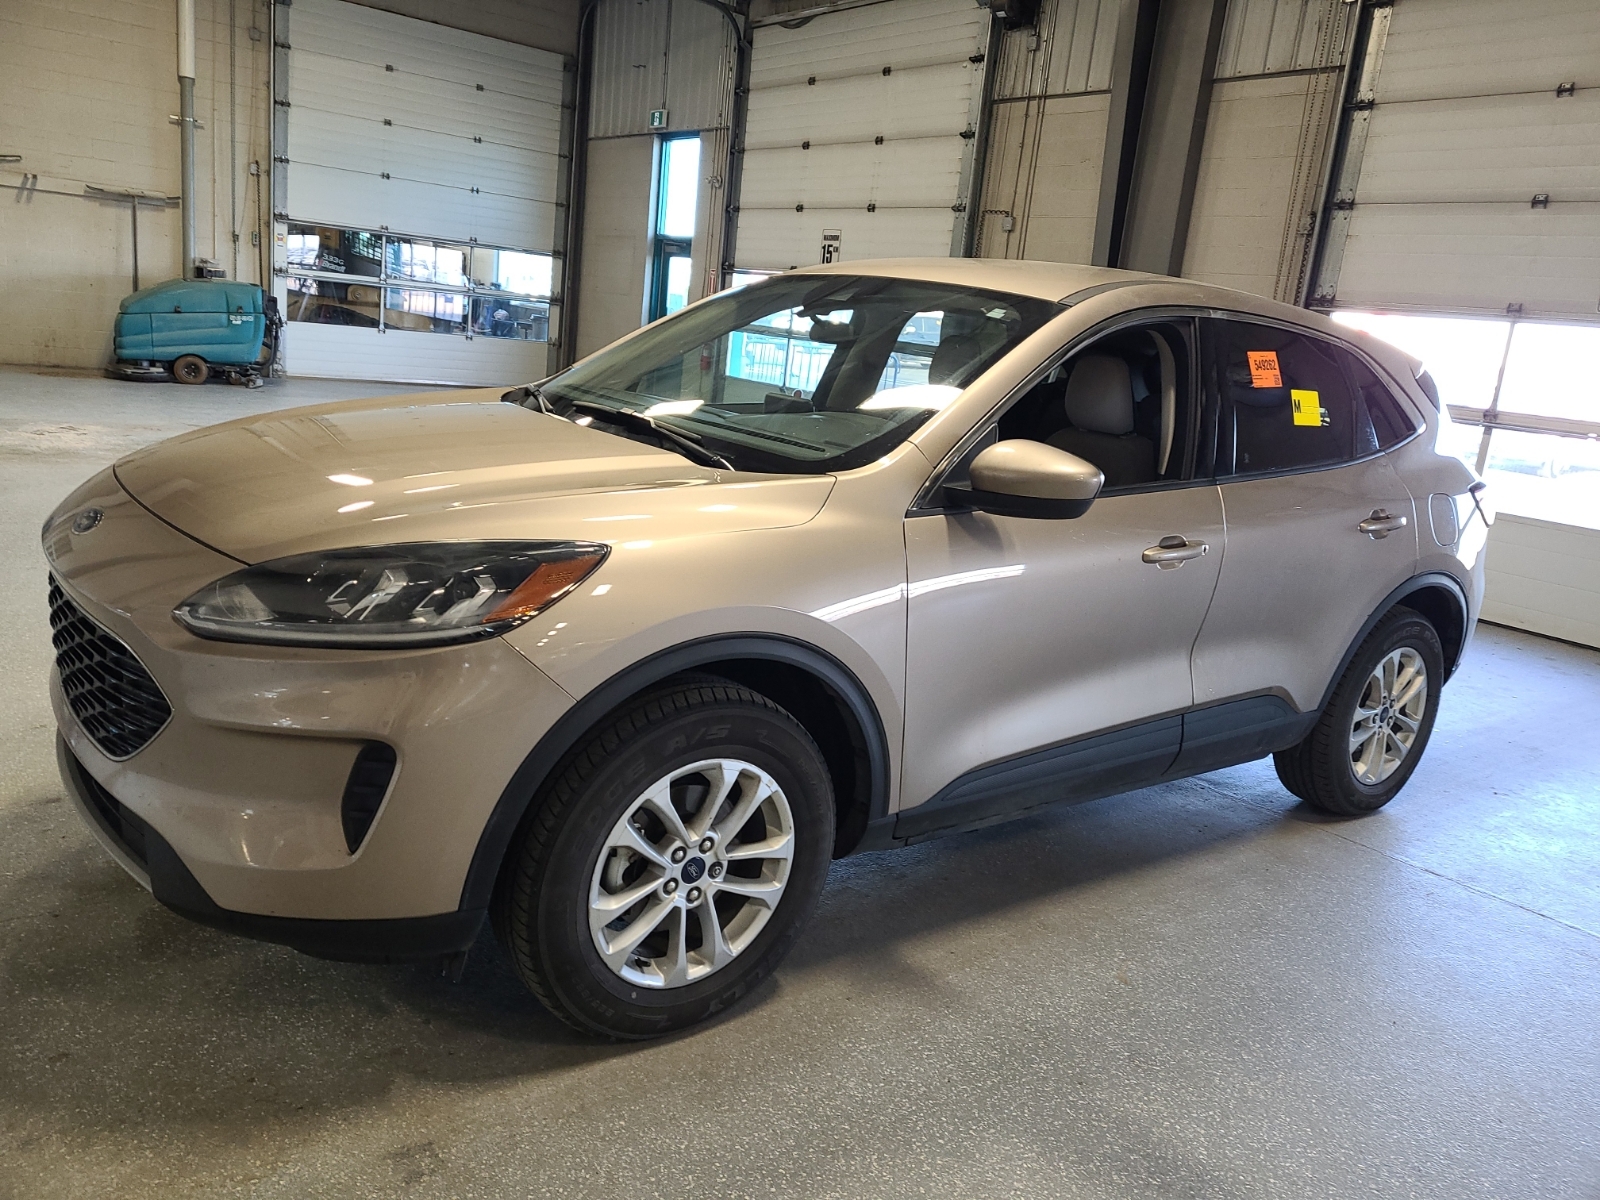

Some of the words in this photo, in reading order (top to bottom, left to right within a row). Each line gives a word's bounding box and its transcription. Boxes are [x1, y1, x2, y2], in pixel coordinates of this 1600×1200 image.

[821, 243, 833, 264] 15
[1253, 359, 1277, 371] 549262
[1293, 399, 1301, 413] M
